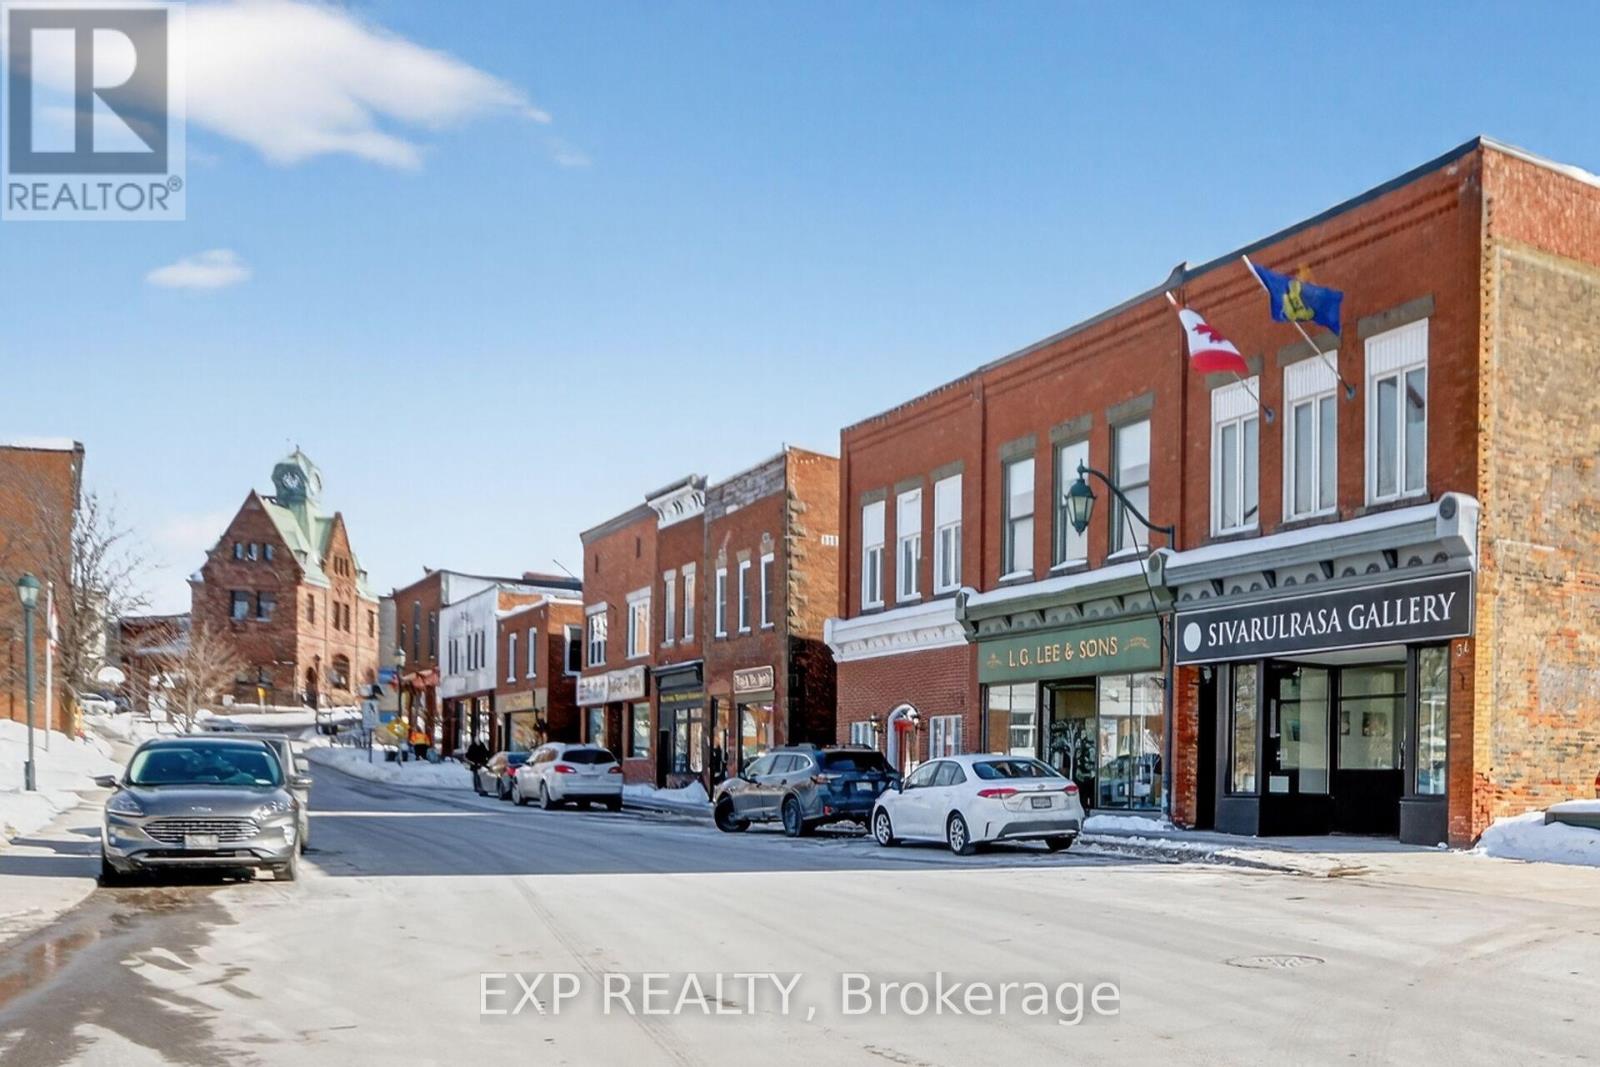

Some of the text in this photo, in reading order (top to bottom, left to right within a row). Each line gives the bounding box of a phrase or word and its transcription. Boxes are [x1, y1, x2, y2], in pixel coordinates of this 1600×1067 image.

[1208, 591, 1456, 646] SIVARULRASA GALLERY
[1009, 648, 1033, 667] L.G.
[1037, 643, 1061, 664] LEE
[1065, 642, 1075, 660] &
[1079, 636, 1118, 659] SONS
